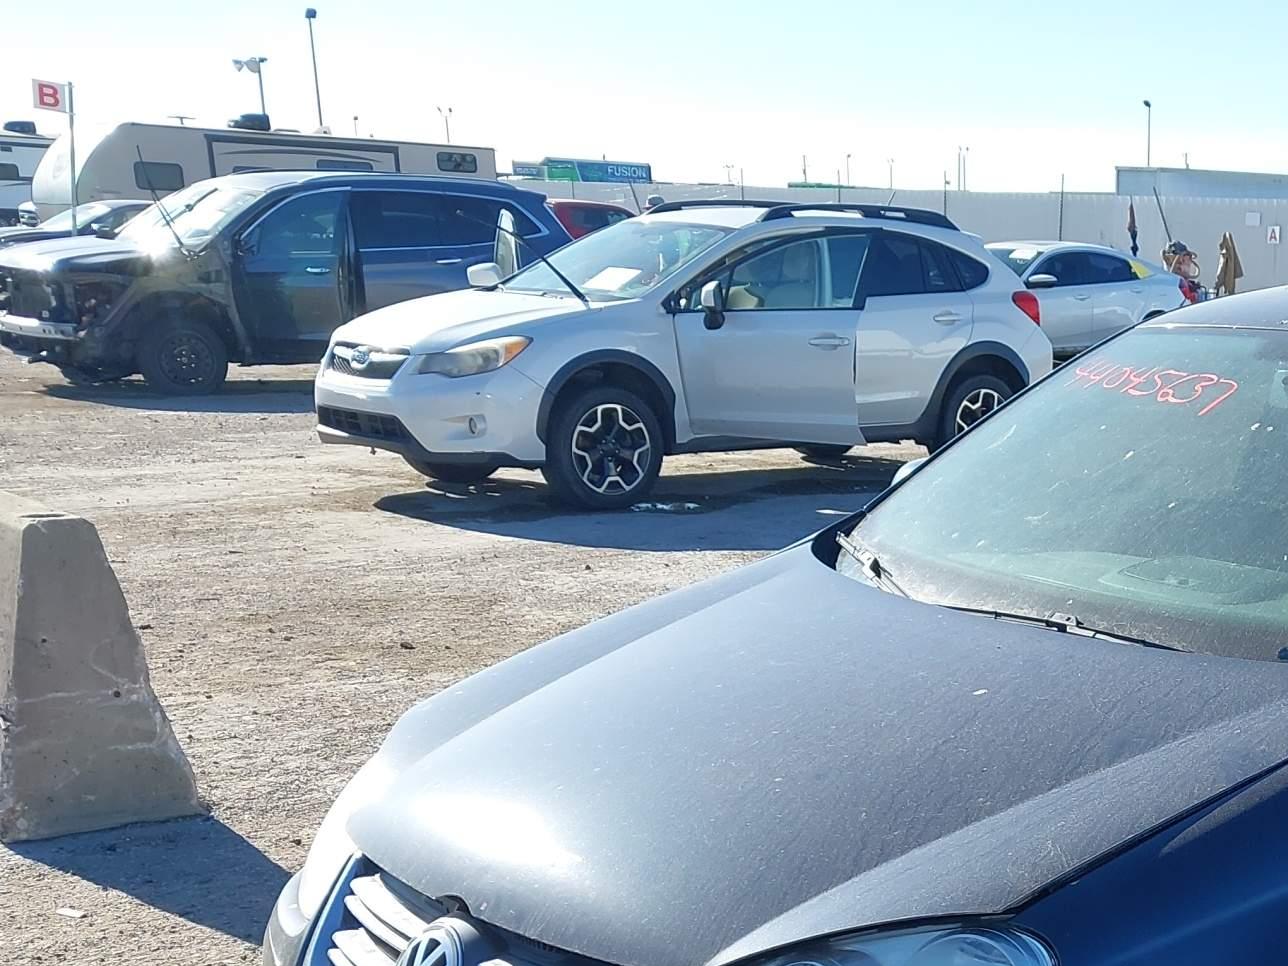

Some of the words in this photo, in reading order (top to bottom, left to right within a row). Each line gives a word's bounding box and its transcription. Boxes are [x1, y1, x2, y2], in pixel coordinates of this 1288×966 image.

[38, 83, 60, 107] B
[607, 165, 648, 178] FUSION
[1269, 228, 1278, 241] A
[1064, 361, 1238, 416] 44045637
